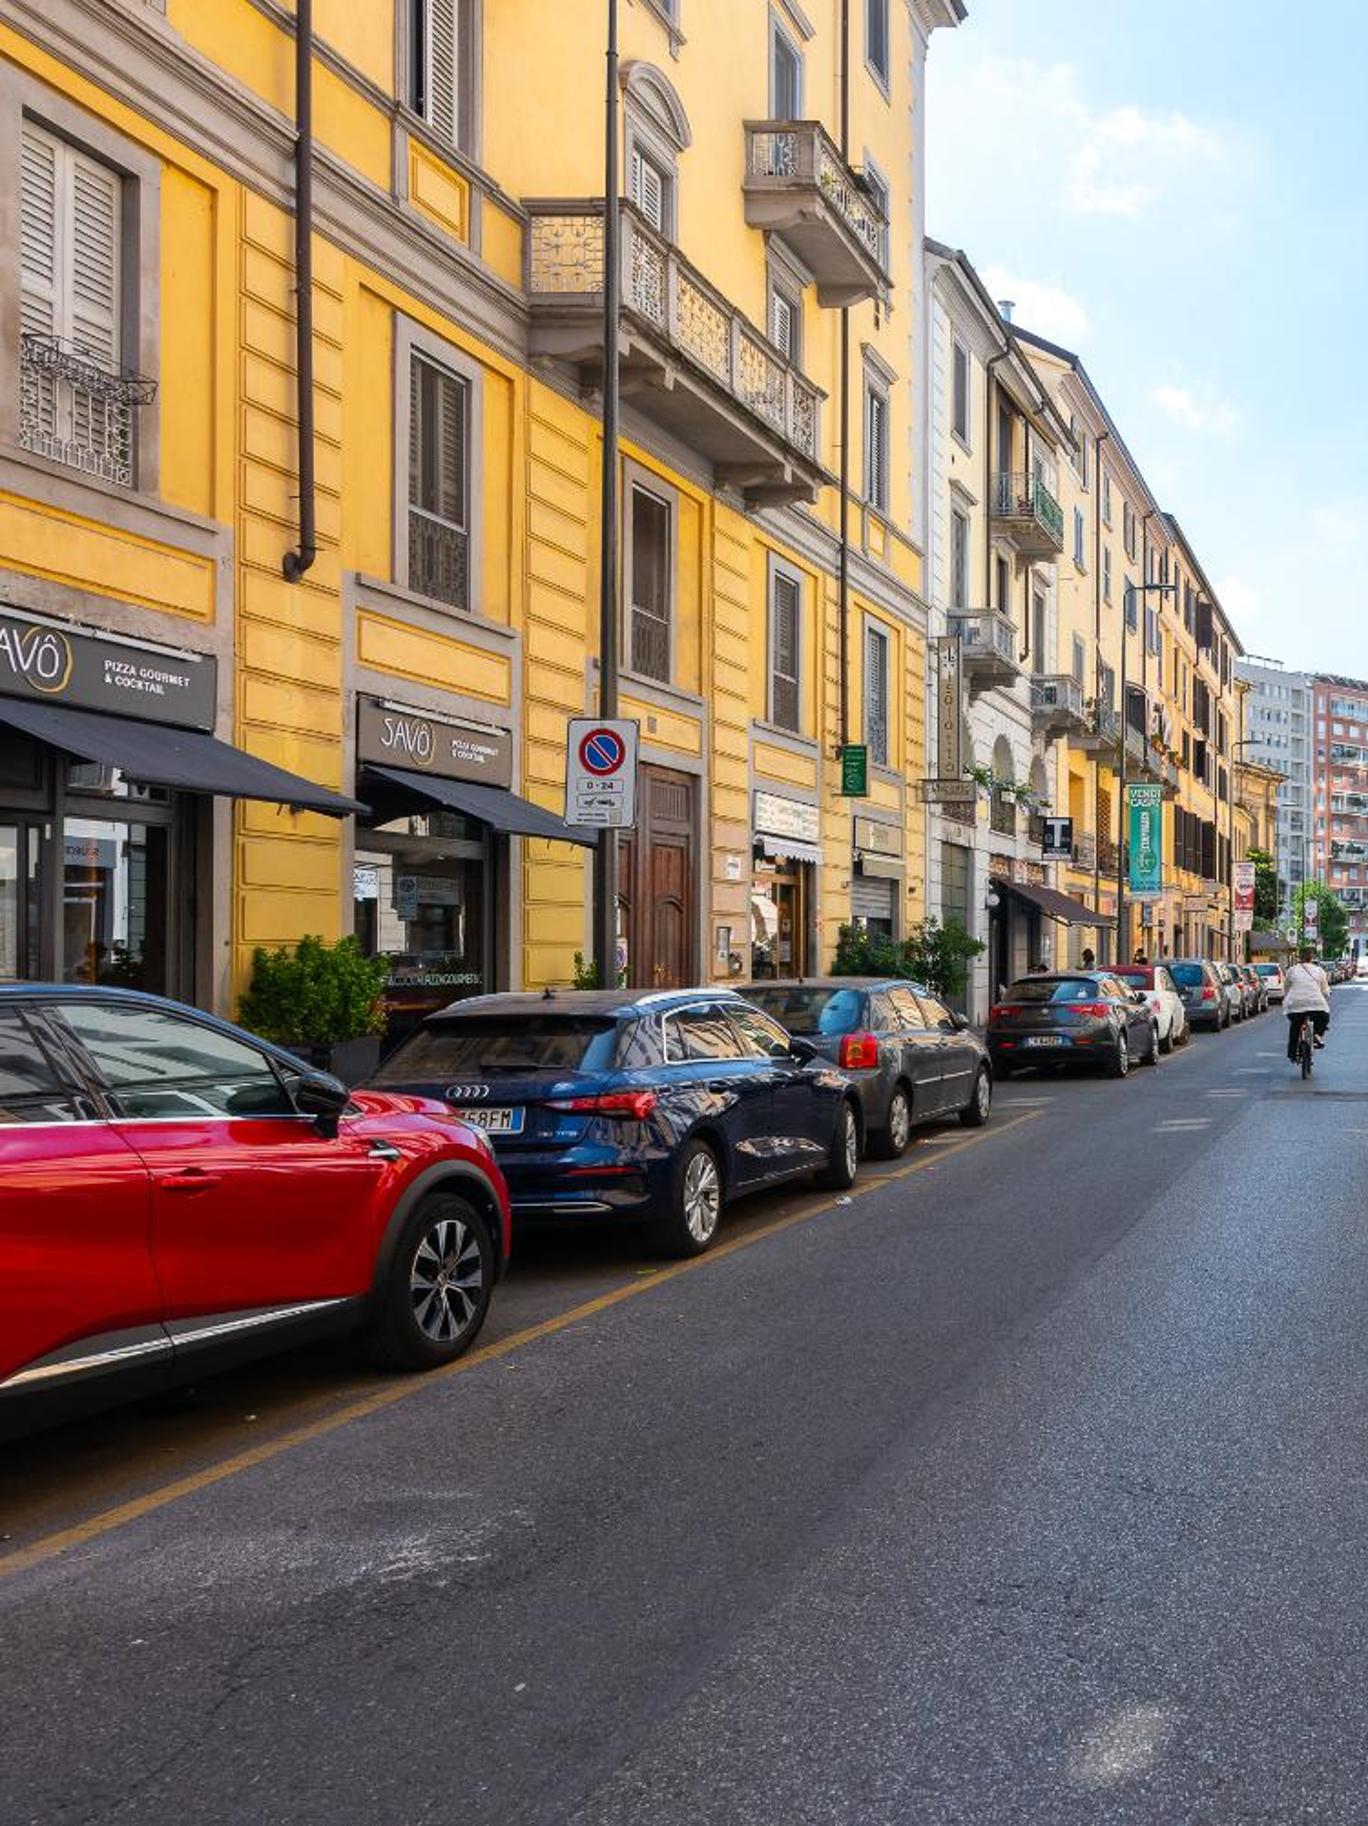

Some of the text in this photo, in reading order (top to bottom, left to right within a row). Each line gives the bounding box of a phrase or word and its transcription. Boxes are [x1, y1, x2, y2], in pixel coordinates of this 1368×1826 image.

[104, 660, 190, 687] PIZZA GOURMET
[104, 672, 165, 695] & COCKTAIL
[381, 718, 430, 756] SAVÔ
[460, 1111, 511, 1128] 58FM
